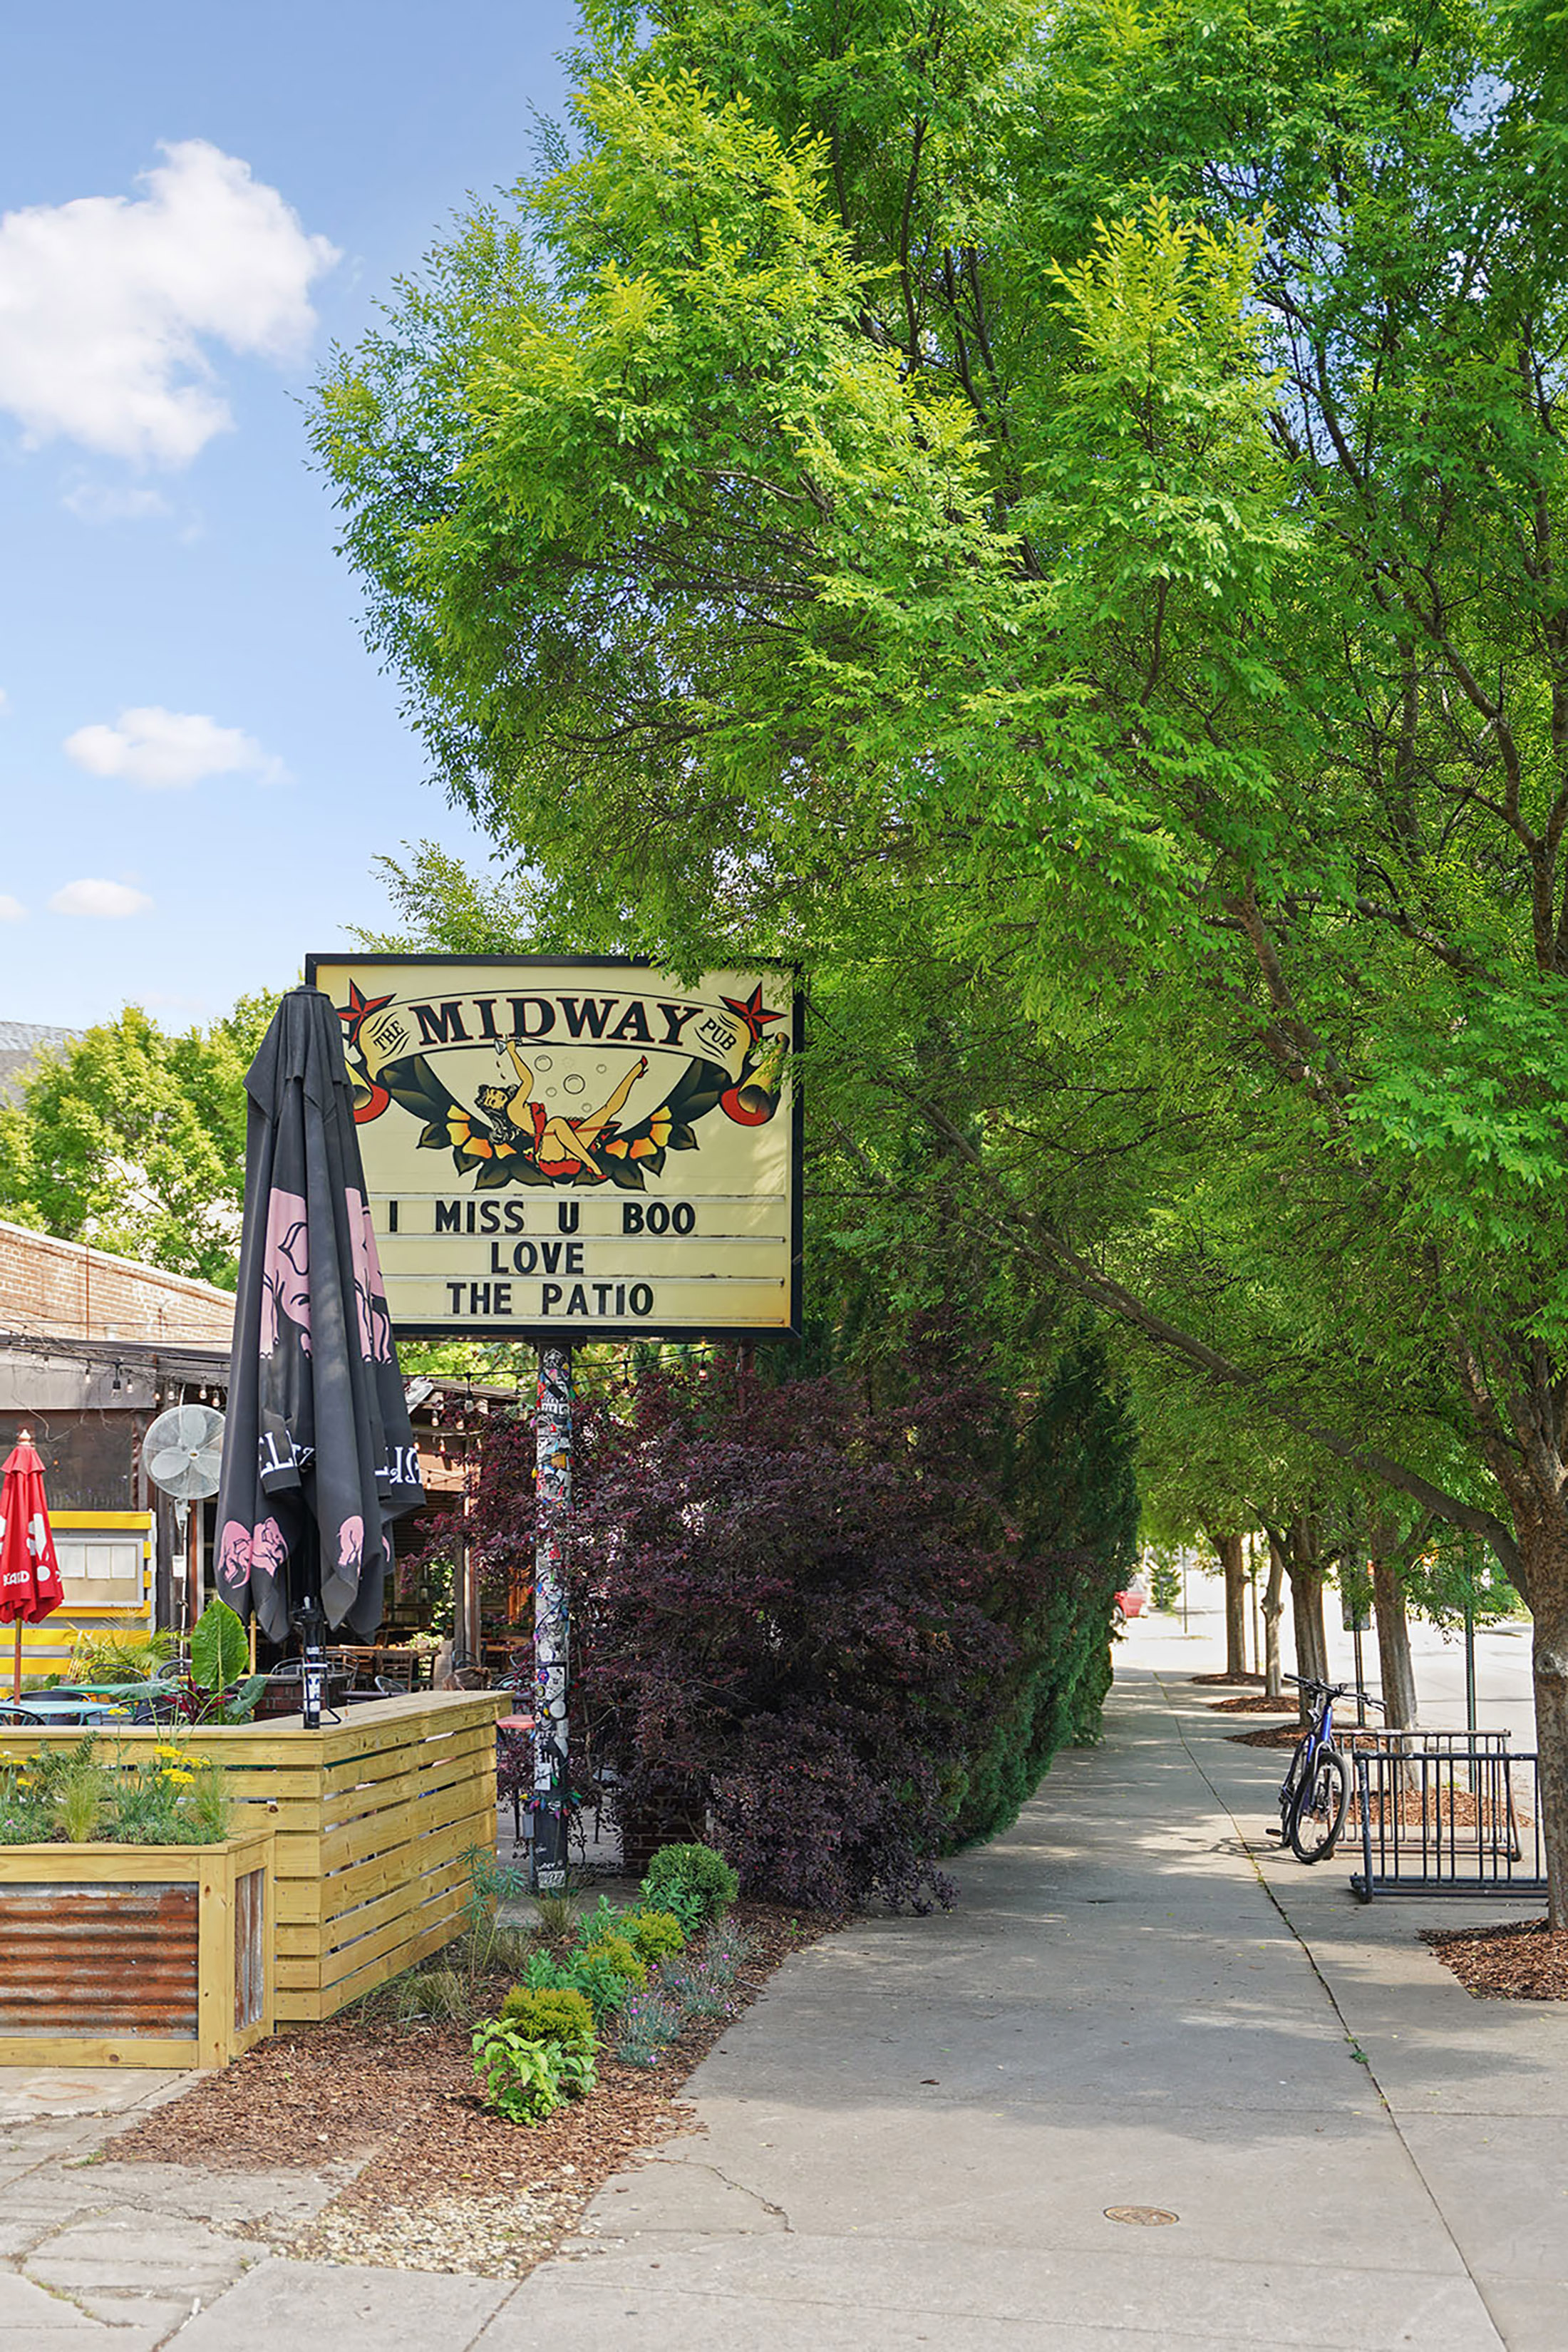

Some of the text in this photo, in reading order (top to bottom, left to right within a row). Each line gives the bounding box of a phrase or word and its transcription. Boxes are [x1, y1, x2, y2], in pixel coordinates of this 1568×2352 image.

[373, 997, 736, 1051] THE MIDWAY PUB
[390, 1200, 695, 1234] I MISS U BOO
[492, 1242, 583, 1274] LOVE
[447, 1283, 653, 1315] THE PATIO
